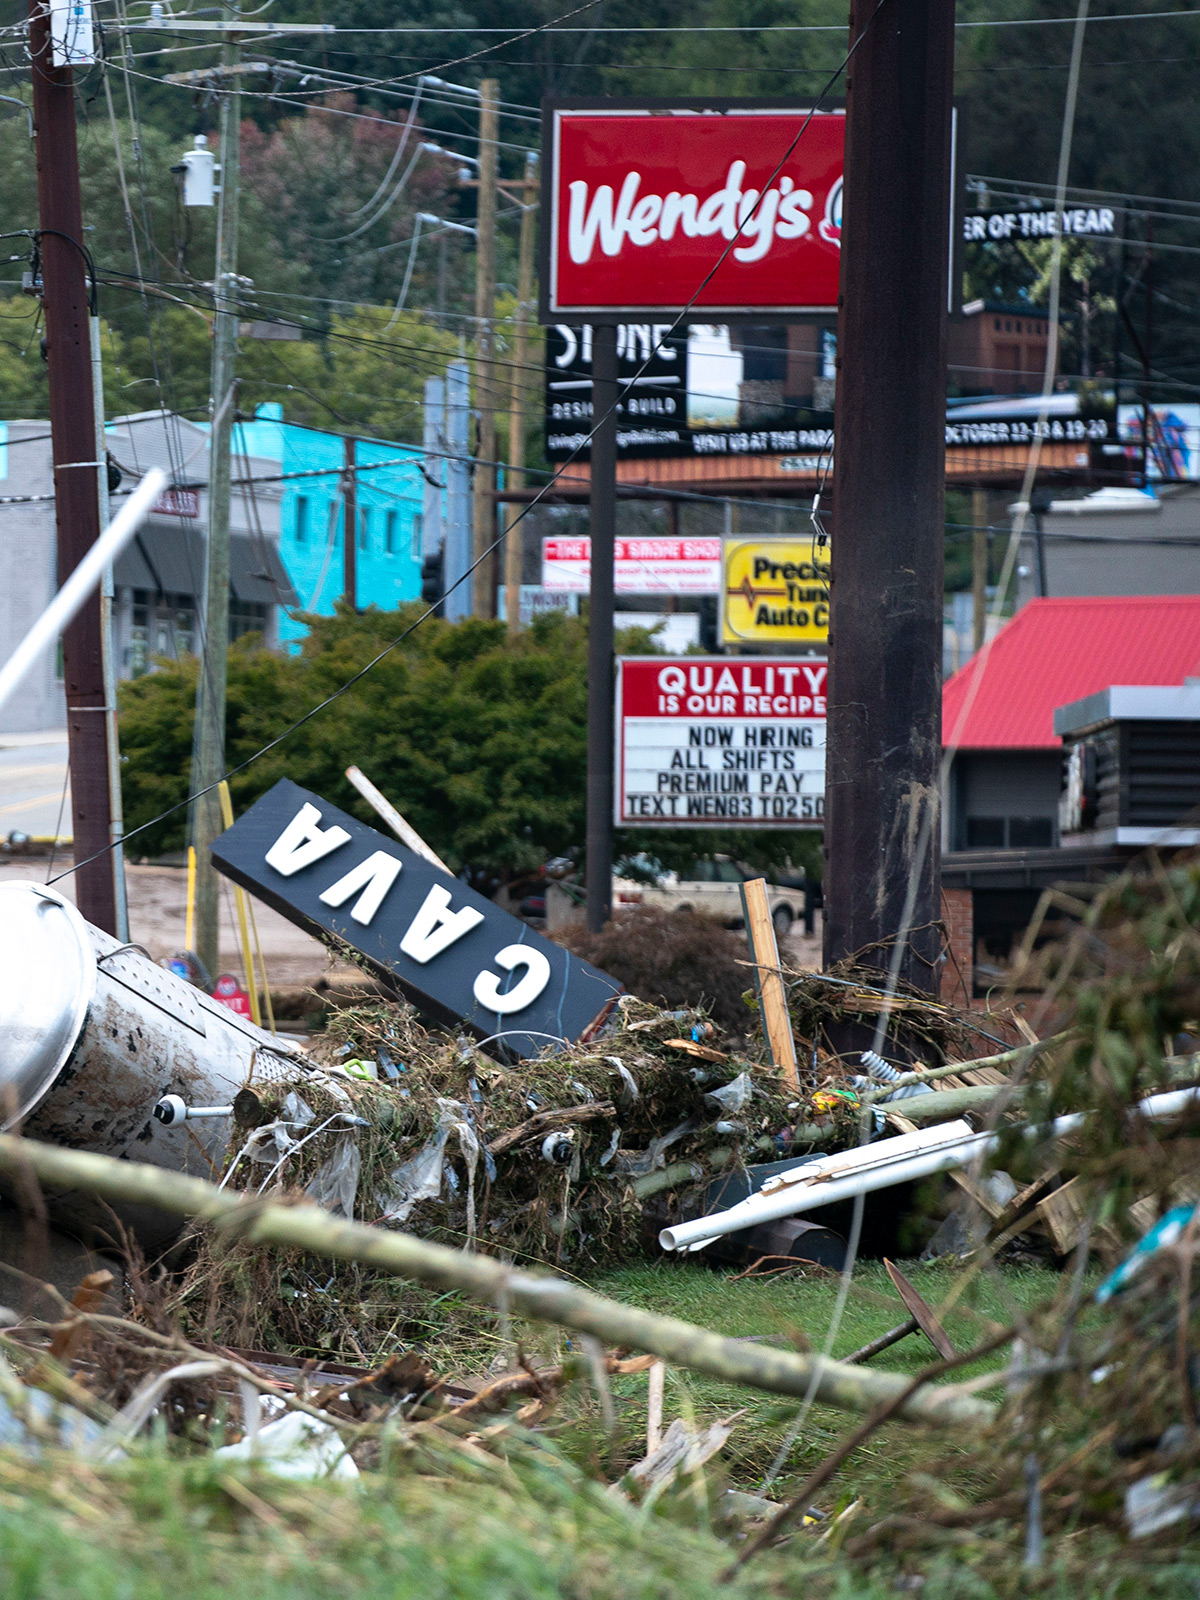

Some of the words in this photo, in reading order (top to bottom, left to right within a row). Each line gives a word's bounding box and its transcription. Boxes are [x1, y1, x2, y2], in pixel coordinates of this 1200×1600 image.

[569, 160, 813, 264] Wendy's
[988, 213, 1017, 239] OF
[1019, 211, 1059, 237] THE
[1062, 208, 1115, 234] YEAR
[756, 604, 809, 627] Auto
[657, 666, 828, 696] QUALITY
[658, 695, 680, 714] IS
[686, 695, 736, 714] OUR
[743, 695, 827, 714] RECIPE
[689, 726, 734, 746] NOW
[745, 726, 813, 747] HIRING
[671, 750, 710, 769] ALL
[723, 750, 795, 770] SHIFTS
[657, 772, 749, 792] PREMIUM
[761, 773, 804, 793] PAY
[627, 795, 679, 816] TEXT
[687, 796, 752, 816] WEN83
[265, 801, 550, 1014] CAVA
